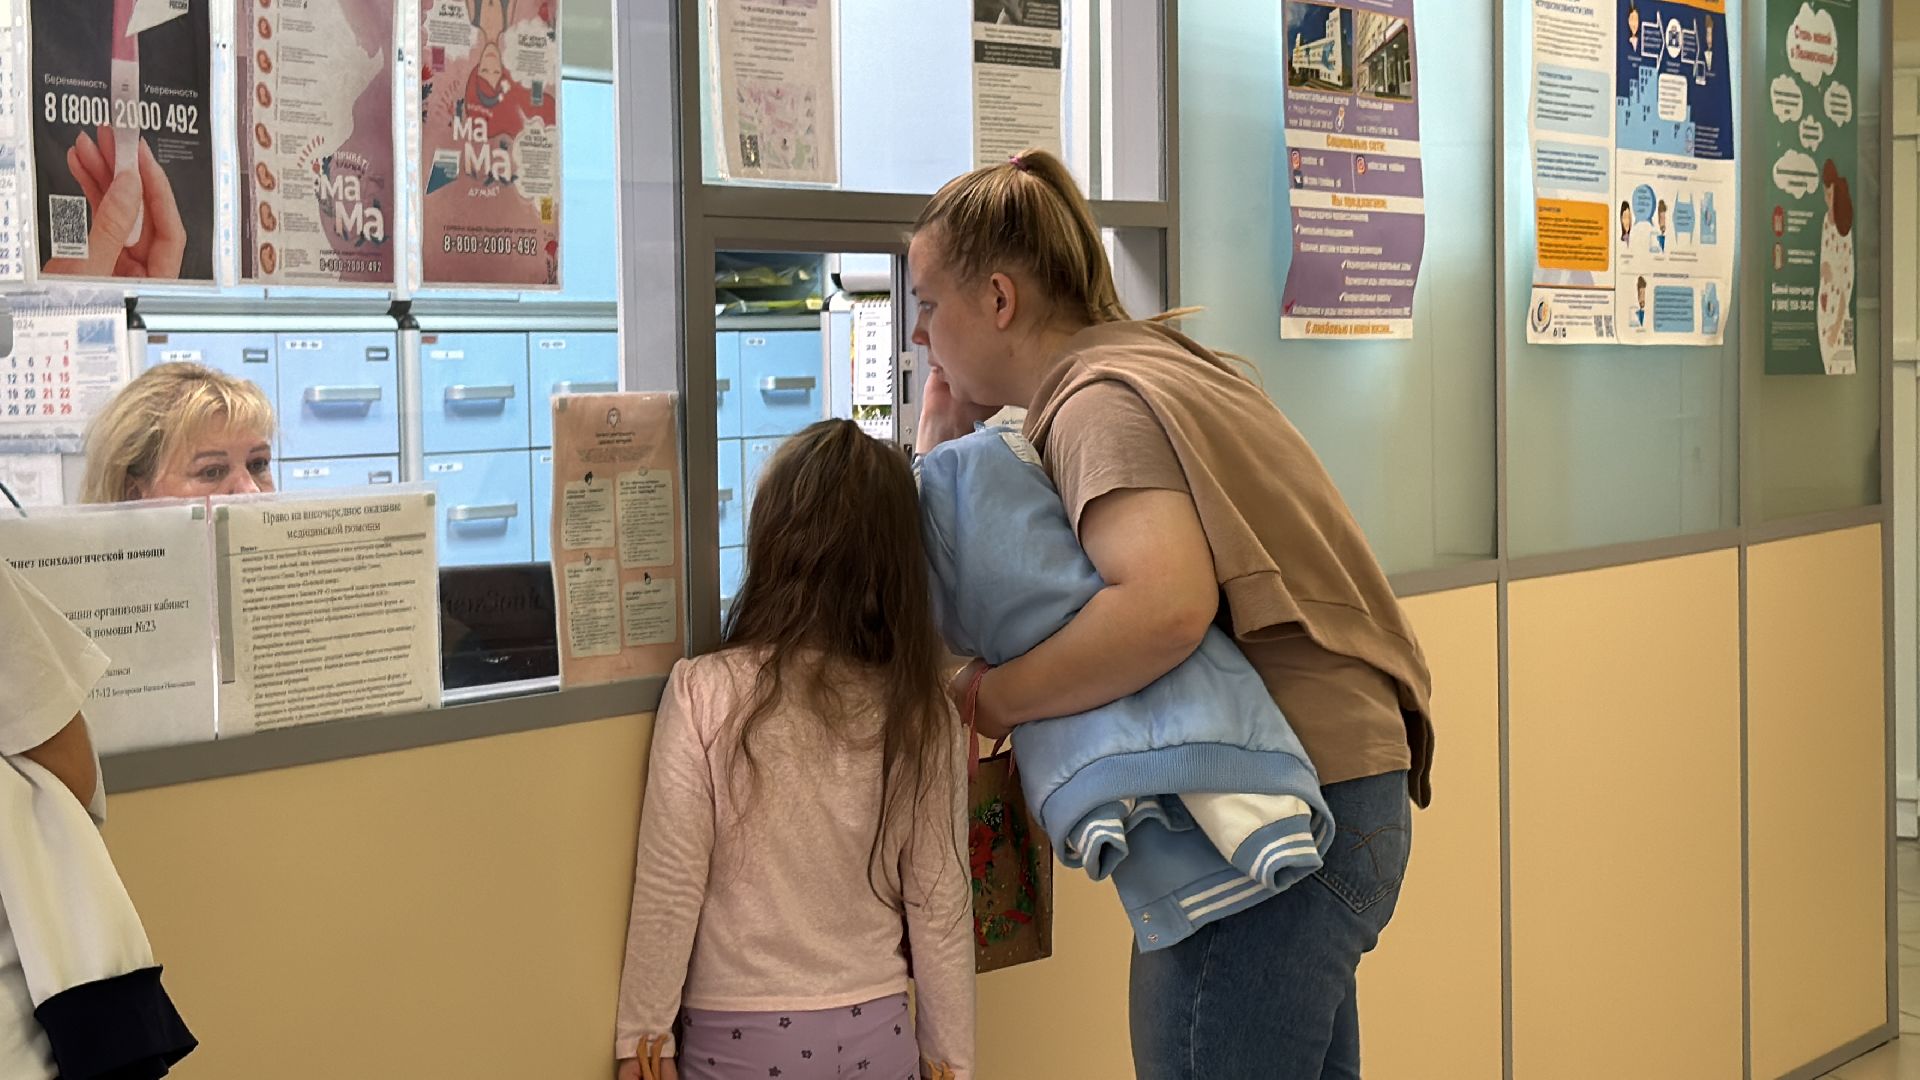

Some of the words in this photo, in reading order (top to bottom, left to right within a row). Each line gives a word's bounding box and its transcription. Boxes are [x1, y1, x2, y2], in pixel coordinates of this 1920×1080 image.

[44, 73, 108, 90] Беременность
[144, 83, 199, 98] Уверенность
[44, 91, 57, 123] 8
[61, 93, 110, 128] (800)
[115, 99, 162, 131] 2000
[165, 103, 198, 135] 492
[453, 115, 489, 143] Ма
[464, 141, 512, 183] Ма
[320, 173, 361, 202] Ма
[335, 200, 385, 242] Ма
[443, 235, 538, 256] 8-800-2000-492
[16, 319, 34, 329] 024
[64, 340, 69, 351] 1
[45, 356, 51, 367] 7
[7, 373, 17, 385] 12
[24, 372, 35, 384] 13
[42, 371, 52, 383] 14
[59, 371, 70, 382] 15
[8, 388, 18, 400] 19
[24, 388, 36, 400] 20
[42, 387, 53, 399] 21
[60, 387, 71, 399] 22
[8, 404, 20, 416] 26
[25, 404, 36, 416] 27
[42, 403, 55, 415] 28
[60, 403, 72, 415] 29
[262, 509, 290, 525] Право
[291, 511, 301, 520] на
[363, 502, 401, 515] оказание
[286, 524, 344, 539] медицинской
[344, 521, 381, 534] помощи
[5, 558, 35, 570] инет
[38, 550, 124, 568] психологической
[127, 547, 166, 560] помощи
[94, 604, 152, 621] организован
[154, 599, 189, 612] кабинет
[94, 626, 133, 639] помощи
[135, 620, 157, 633] №23
[87, 686, 111, 699] -17-12
